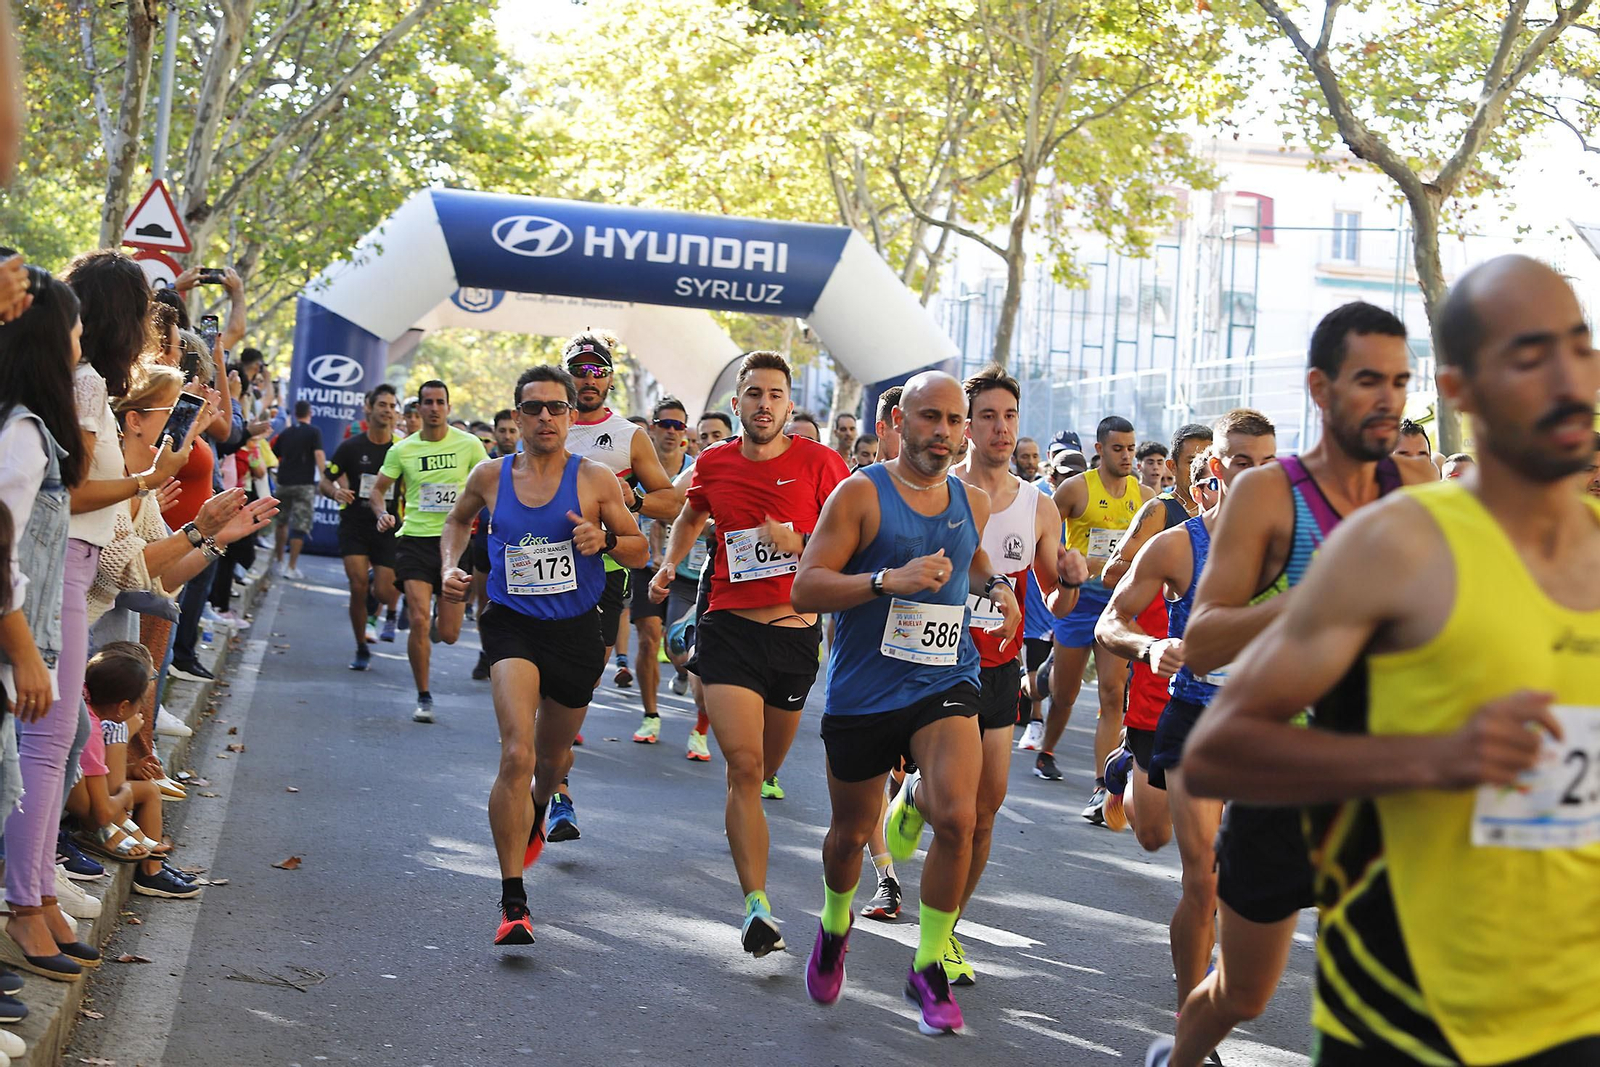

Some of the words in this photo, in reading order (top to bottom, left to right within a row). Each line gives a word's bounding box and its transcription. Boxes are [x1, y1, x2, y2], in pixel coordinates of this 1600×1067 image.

[583, 225, 788, 273] HYUNDAI
[674, 277, 784, 304] SYRLUZ
[296, 387, 366, 407] HYUNDA
[427, 454, 457, 470] RUN
[435, 491, 457, 504] 342
[533, 555, 571, 580] 173
[921, 621, 959, 648] 586
